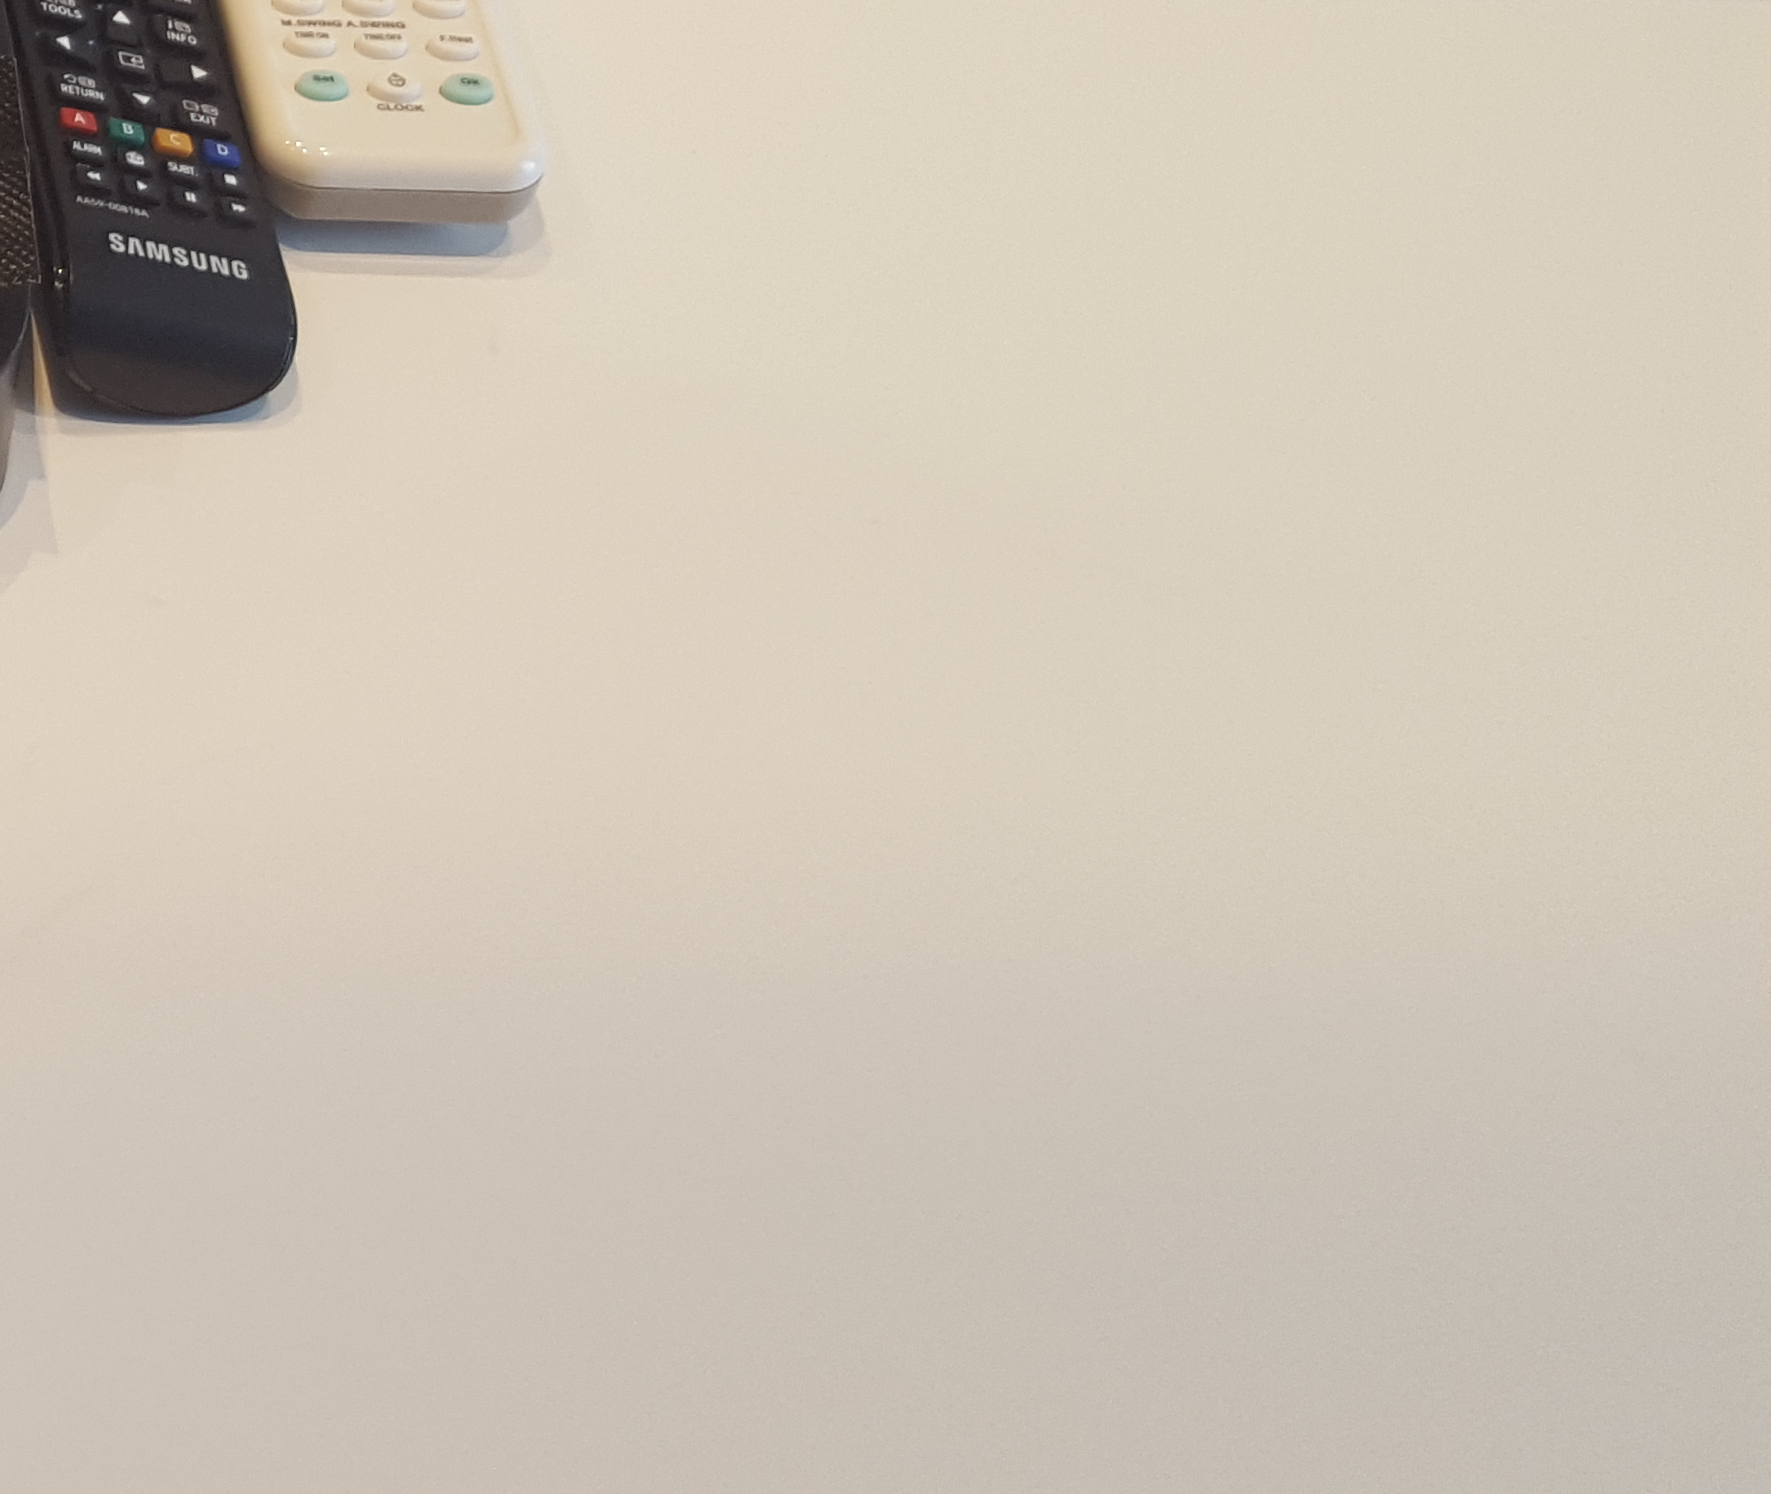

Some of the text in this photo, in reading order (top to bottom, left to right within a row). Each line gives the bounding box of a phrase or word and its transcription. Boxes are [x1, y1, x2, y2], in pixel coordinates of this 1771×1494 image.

[40, 1, 82, 19] TOOLS
[167, 30, 197, 45] INFO
[60, 83, 106, 102] RETURN
[376, 103, 426, 112] CLOCK
[74, 112, 86, 125] A
[190, 112, 218, 127] EXIT
[122, 122, 134, 135] B
[169, 133, 181, 145] C
[216, 143, 229, 156] D
[108, 232, 250, 280] SAMSUNG
